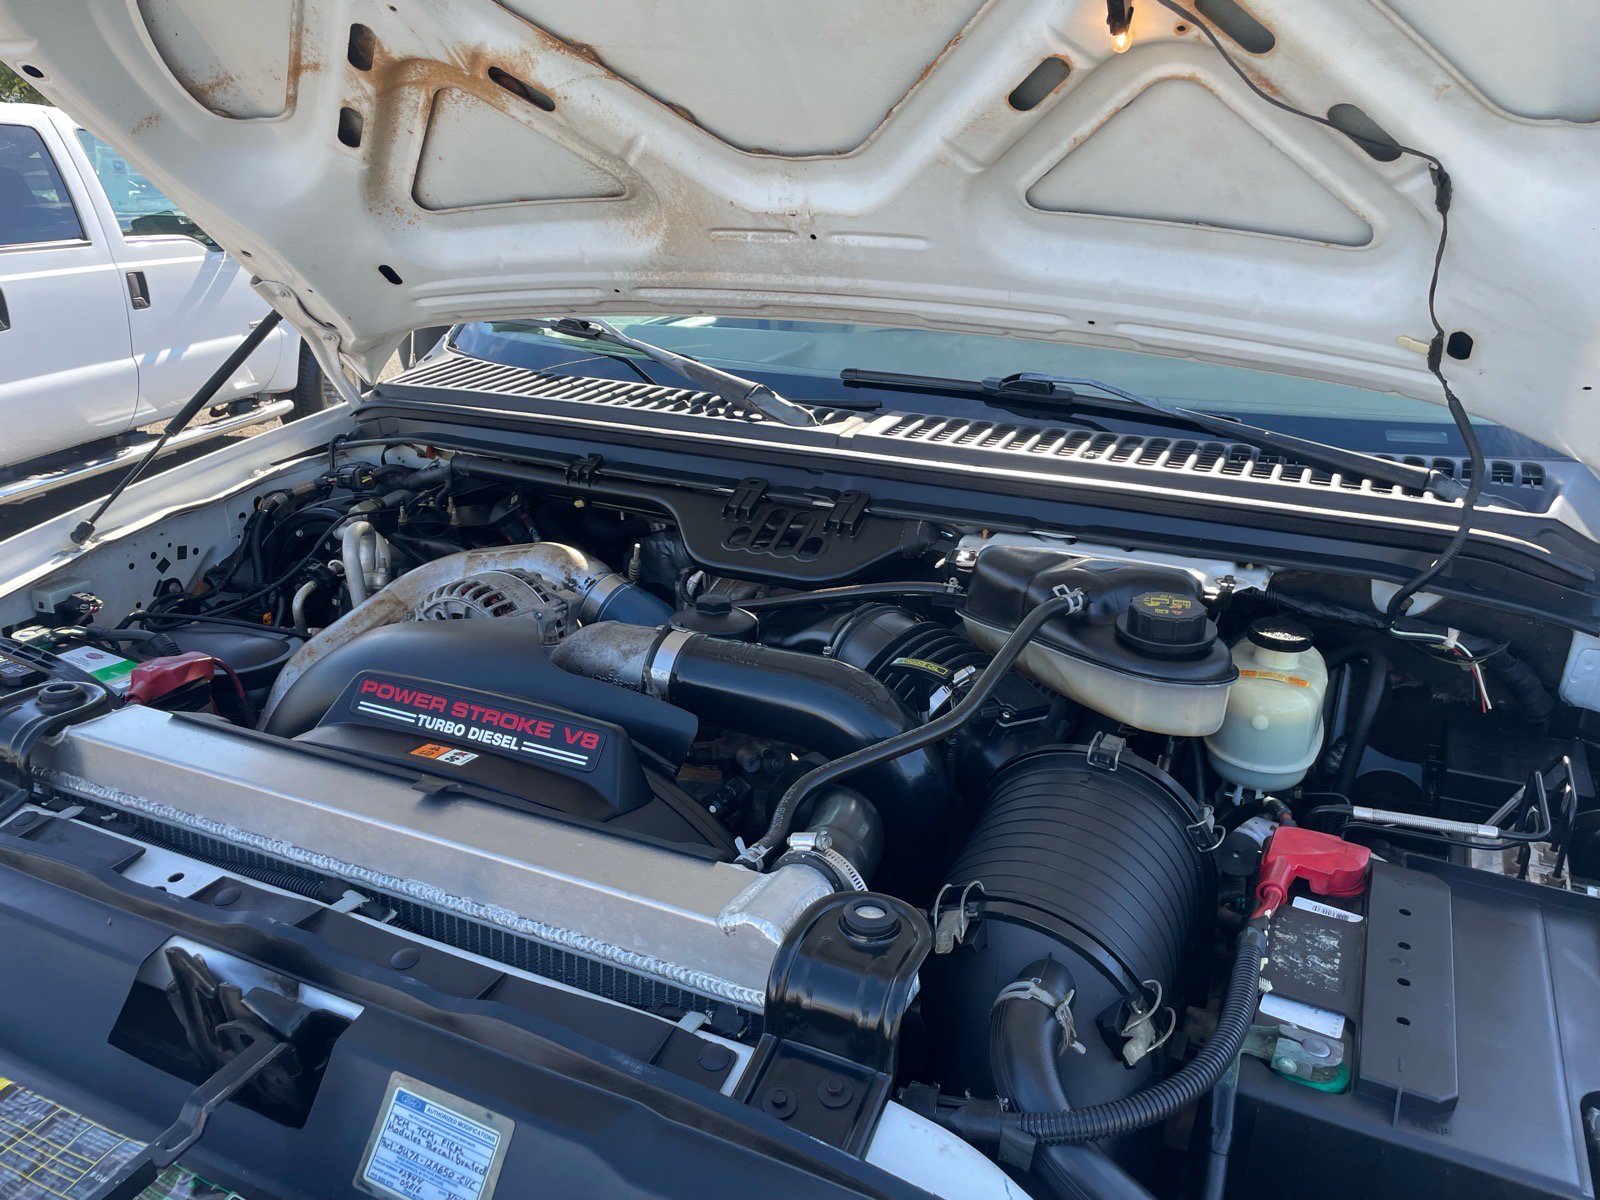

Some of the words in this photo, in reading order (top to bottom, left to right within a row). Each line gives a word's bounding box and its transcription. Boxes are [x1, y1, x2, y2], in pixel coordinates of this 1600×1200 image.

[360, 679, 448, 713] POWER
[451, 701, 555, 739] STROKE
[564, 727, 600, 750] V8
[417, 713, 466, 737] TURBO
[467, 727, 519, 751] DIESEL
[426, 1107, 457, 1125] AUTHORIZED
[457, 1120, 496, 1144] MODIFICATIONS
[387, 1122, 421, 1146] Modules
[426, 1140, 488, 1176] Recalibrated
